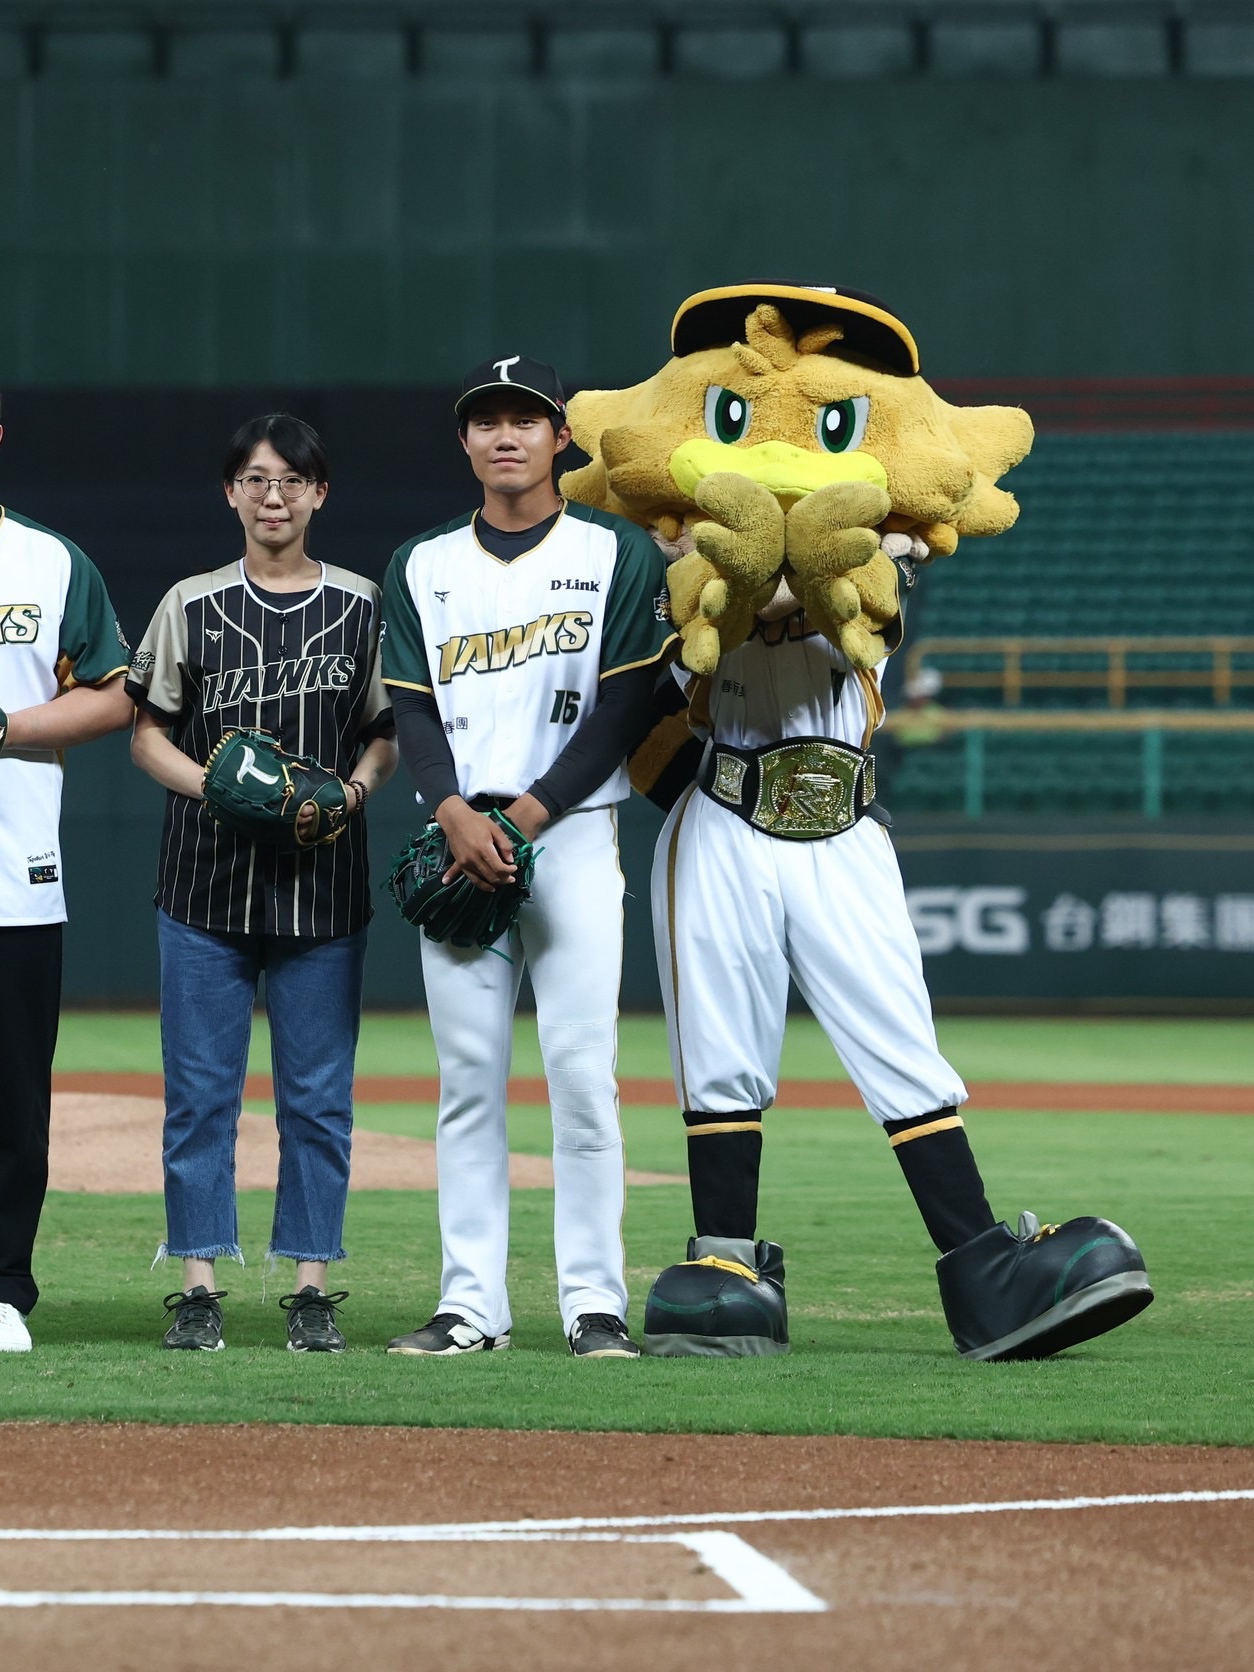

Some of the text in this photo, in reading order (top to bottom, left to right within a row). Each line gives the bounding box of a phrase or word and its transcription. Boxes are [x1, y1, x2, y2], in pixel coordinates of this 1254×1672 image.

[550, 579, 600, 592] D-Link
[203, 654, 356, 713] HAWKS
[549, 689, 581, 725] 16
